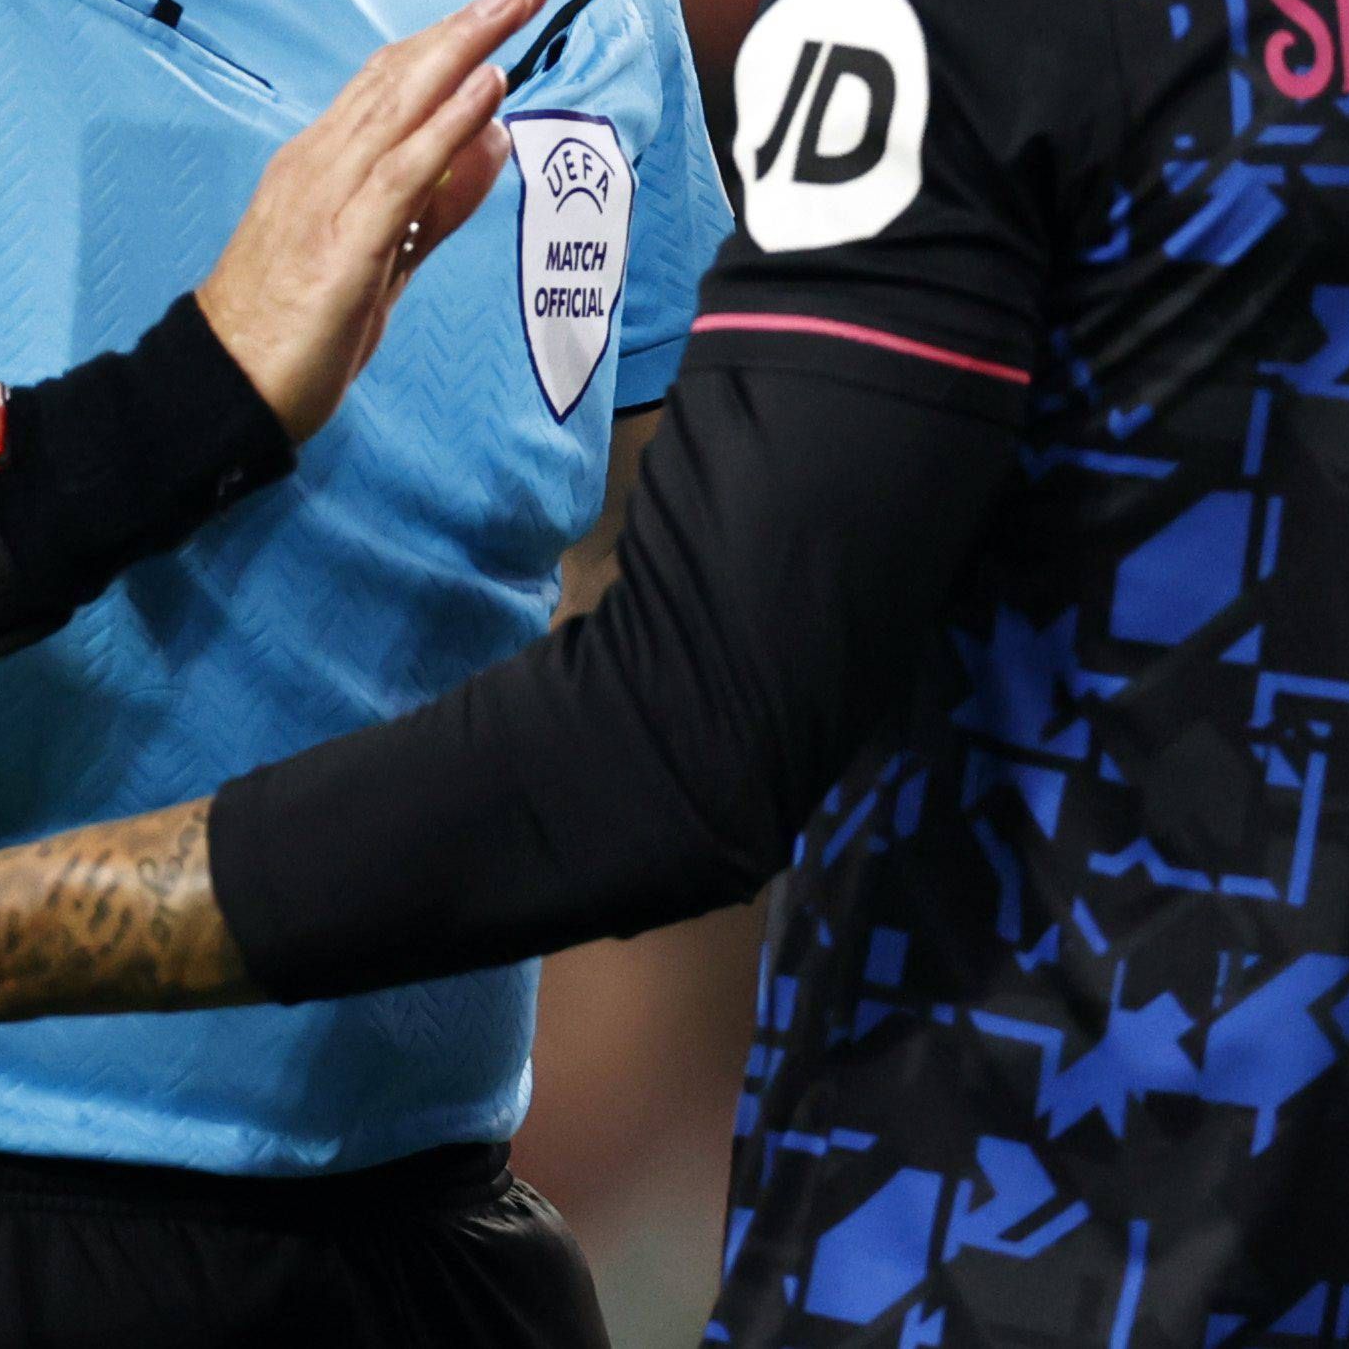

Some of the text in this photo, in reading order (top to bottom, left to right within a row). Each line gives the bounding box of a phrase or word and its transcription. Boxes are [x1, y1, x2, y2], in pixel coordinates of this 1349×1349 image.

[754, 39, 897, 186] JD
[546, 150, 609, 202] UEFA
[546, 241, 608, 272] MATCH
[534, 287, 605, 318] OFFICIAL
